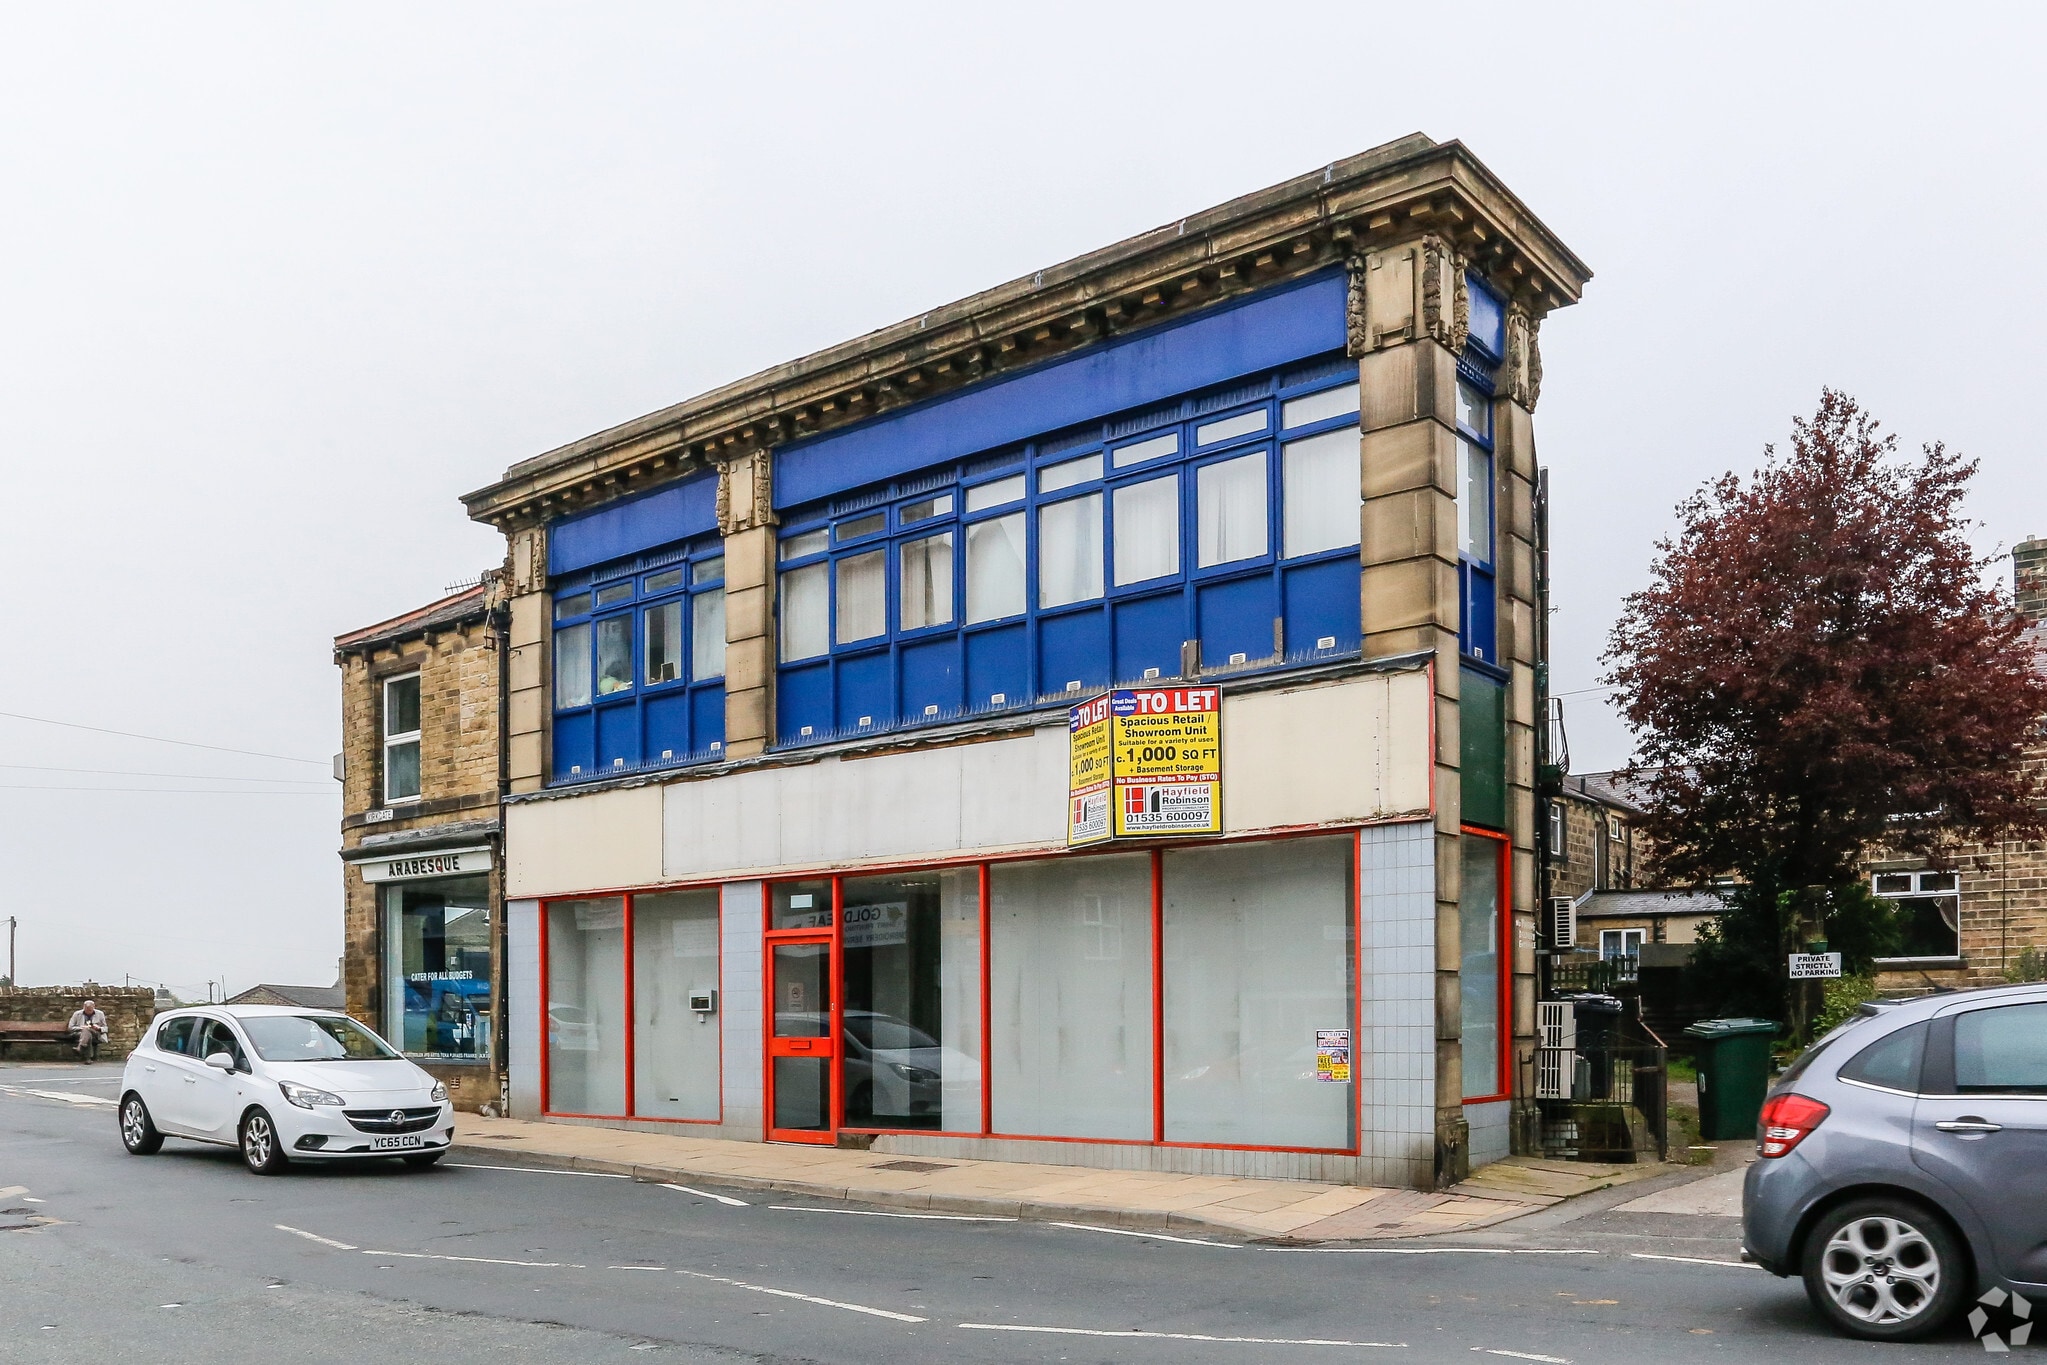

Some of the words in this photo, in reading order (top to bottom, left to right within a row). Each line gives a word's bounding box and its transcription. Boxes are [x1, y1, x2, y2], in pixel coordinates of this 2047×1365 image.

[1137, 692, 1168, 713] TO
[1174, 690, 1215, 712] LET
[1078, 706, 1090, 727] TO
[1092, 698, 1109, 722] LET
[1120, 716, 1169, 728] Spacious
[1173, 714, 1204, 724] Retail
[1073, 730, 1091, 742] Spacious
[1125, 728, 1181, 738] Showroom
[1185, 726, 1207, 735] Unit
[1074, 739, 1096, 752] Showroom
[1096, 734, 1106, 744] Unit
[1182, 749, 1199, 760] SQ
[1202, 749, 1216, 759] FT
[1095, 759, 1102, 769] SQ
[1103, 756, 1109, 766] FT
[1136, 765, 1173, 774] Basement
[1175, 763, 1204, 772] Storage
[1126, 776, 1156, 784] Business
[1186, 774, 1198, 782] Pay
[1162, 787, 1209, 797] Hayfield
[1162, 796, 1209, 805] Robinson
[1126, 813, 1162, 822] 01535
[1166, 811, 1209, 821] 600097
[1126, 822, 1209, 830] www.hayfieldrobinson.co.uk
[388, 855, 460, 876] ARABESQUE
[411, 972, 427, 981] CATER
[428, 971, 437, 980] FOR
[439, 971, 448, 980] ALL
[449, 970, 473, 980] BUDGETS
[374, 1137, 400, 1148] YC65
[402, 1136, 421, 1145] CCN
